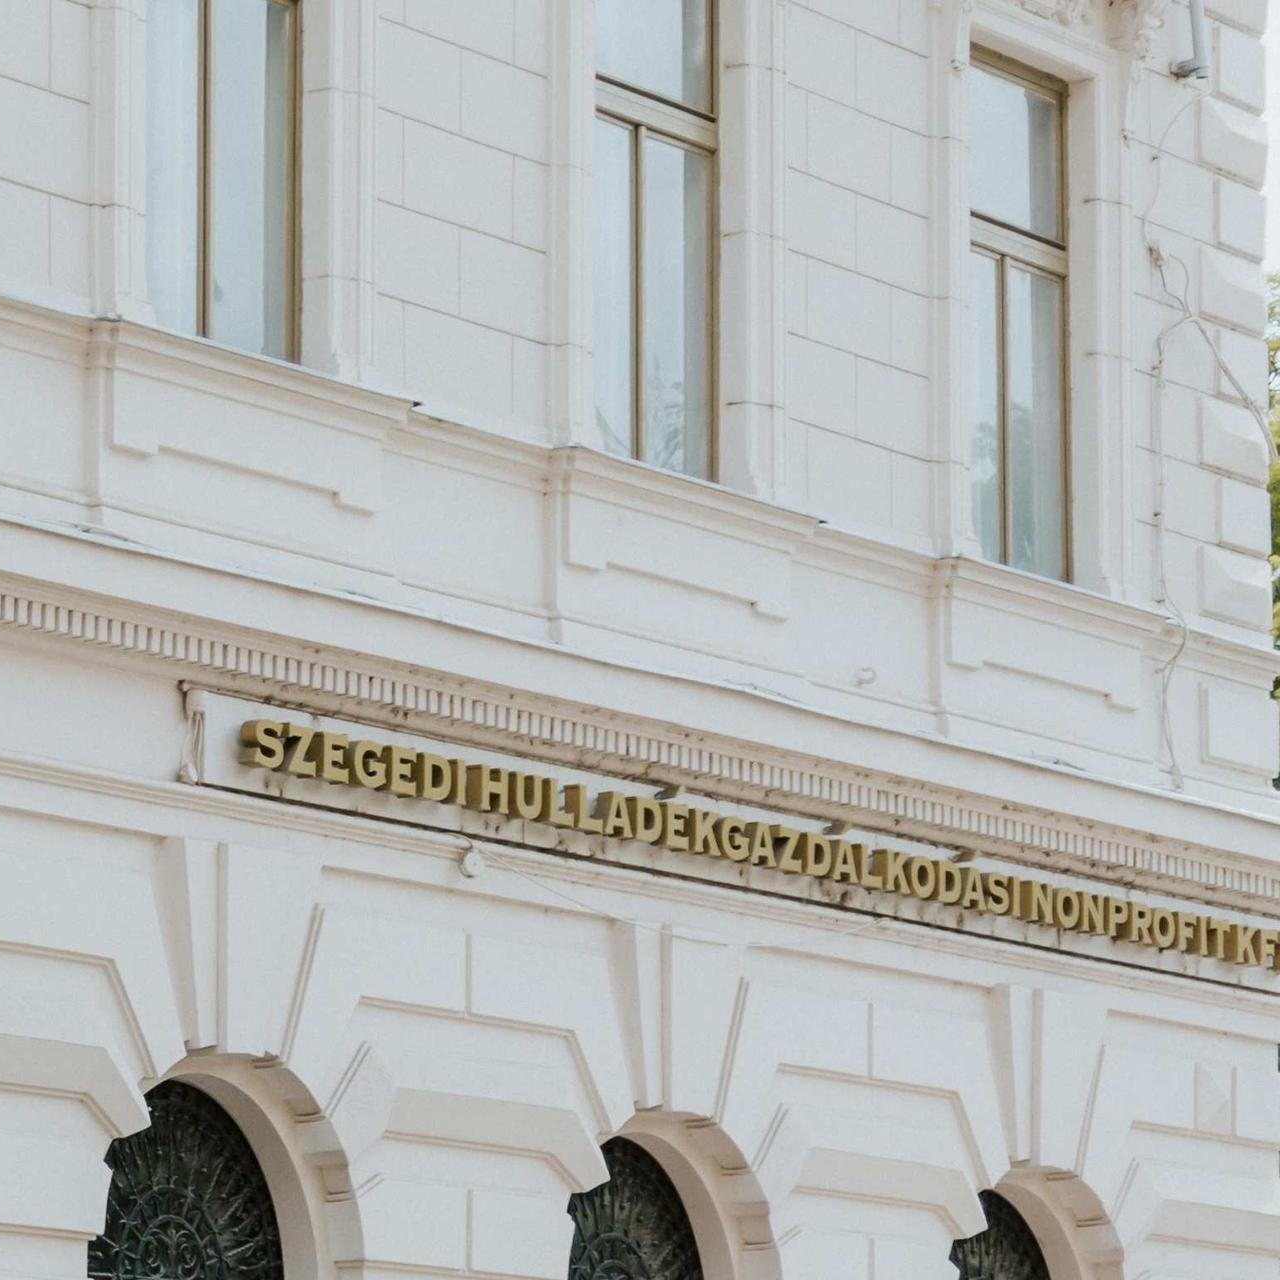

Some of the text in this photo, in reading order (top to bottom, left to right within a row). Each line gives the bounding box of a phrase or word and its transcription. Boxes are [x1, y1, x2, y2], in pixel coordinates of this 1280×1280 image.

[240, 718, 467, 807] SZEGEDI
[1023, 882, 1230, 959] NONPROFIT
[1230, 924, 1280, 972] KF
